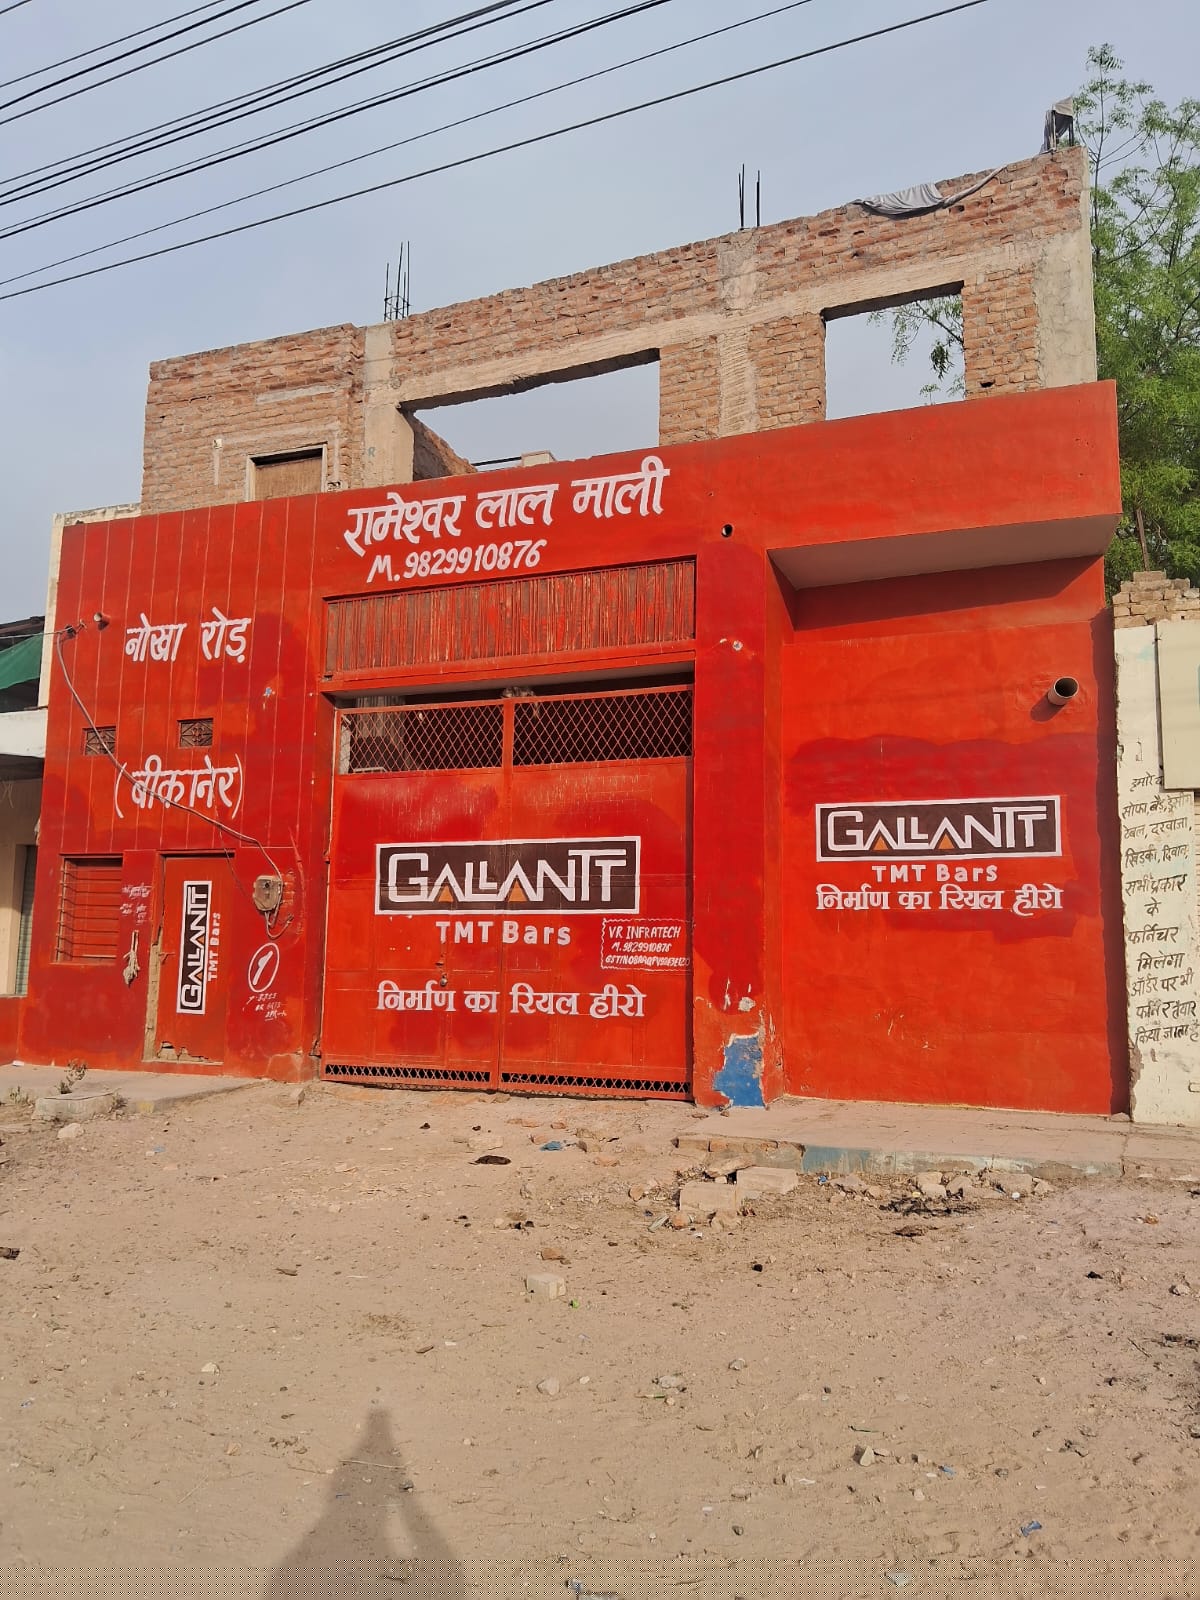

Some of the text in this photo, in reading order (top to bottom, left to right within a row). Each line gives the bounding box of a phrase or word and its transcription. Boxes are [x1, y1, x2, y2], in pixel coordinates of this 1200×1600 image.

[343, 455, 671, 557] रामेश्वर लाल माली
[366, 538, 548, 584] M.9829910876
[124, 606, 252, 664] नोखा रोड़
[827, 805, 1047, 852] GALLANTT
[387, 848, 627, 903] GALLANTT
[871, 863, 998, 883] TMT Bars
[815, 882, 1064, 917] निर्माण का रियल हीरो
[1144, 897, 1162, 917] के
[180, 886, 208, 1008] GALLANTT
[207, 912, 221, 982] TMT Bars
[435, 920, 572, 945] TMT Bars
[608, 925, 681, 940] VR INFRATECH
[1127, 923, 1180, 945] फर्निचर
[1136, 949, 1186, 973] मिलेगा
[1160, 976, 1179, 992] पर
[1180, 966, 1195, 986] भी
[376, 979, 648, 1019] निर्माण का रियल हीरो
[1135, 1025, 1162, 1048] किया
[1163, 1024, 1190, 1039] जाता
